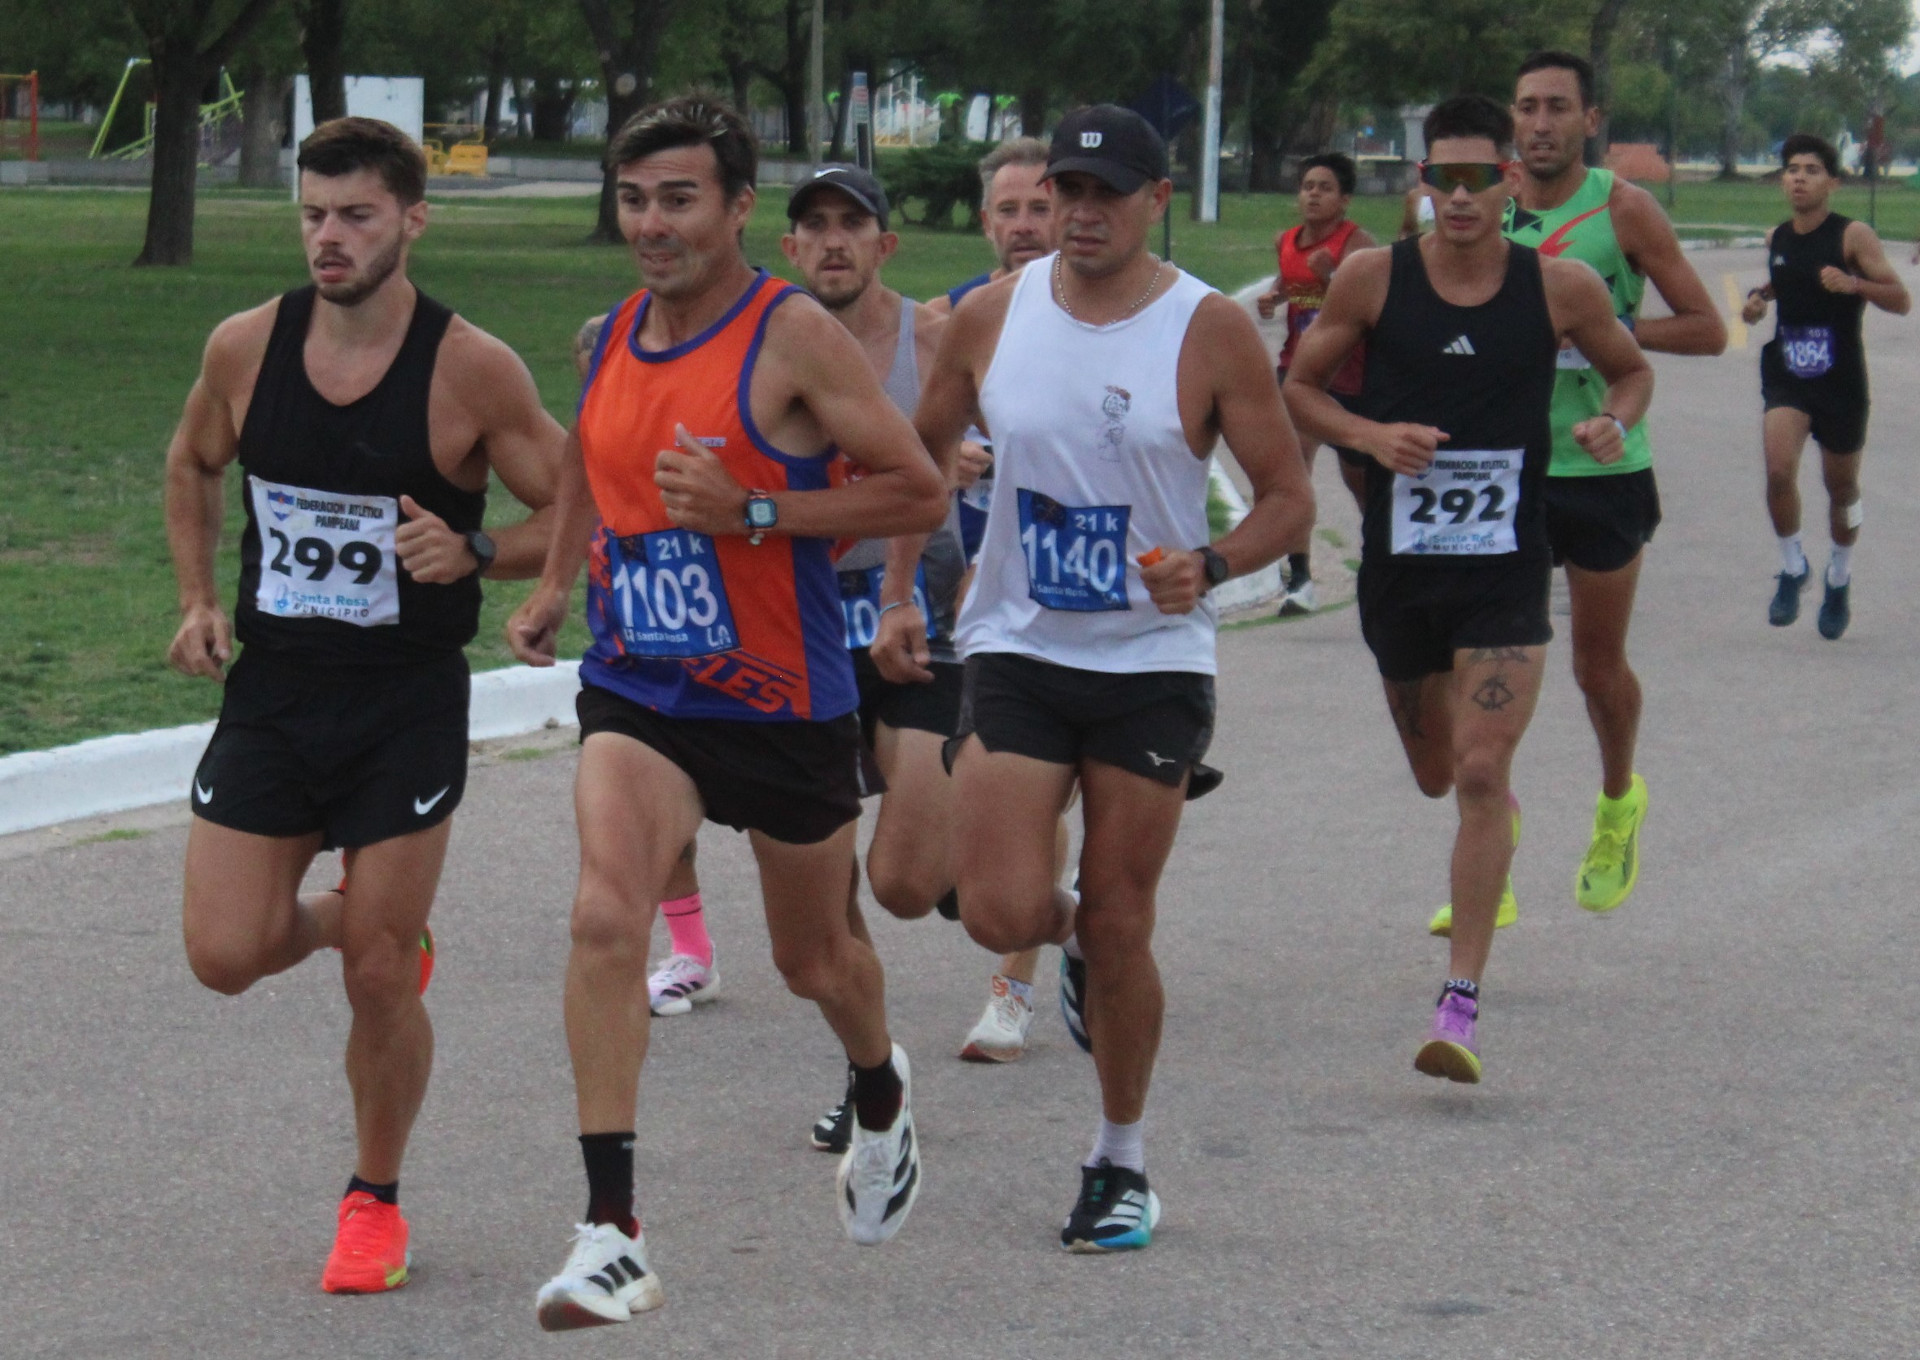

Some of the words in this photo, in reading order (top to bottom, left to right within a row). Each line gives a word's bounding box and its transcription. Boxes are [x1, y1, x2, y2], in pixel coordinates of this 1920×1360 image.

[1435, 460, 1479, 470] FEDERACION
[296, 498, 346, 515] FEDERACION
[349, 504, 384, 519] ATLETICA
[1410, 485, 1506, 524] 292
[315, 515, 361, 531] PAMPEANA
[1074, 513, 1098, 531] 21
[269, 527, 382, 585] 299
[657, 535, 682, 561] 21
[1022, 523, 1118, 592] 1140
[291, 591, 331, 605] Santa
[335, 594, 369, 607] Rosa
[613, 563, 719, 630] 1103
